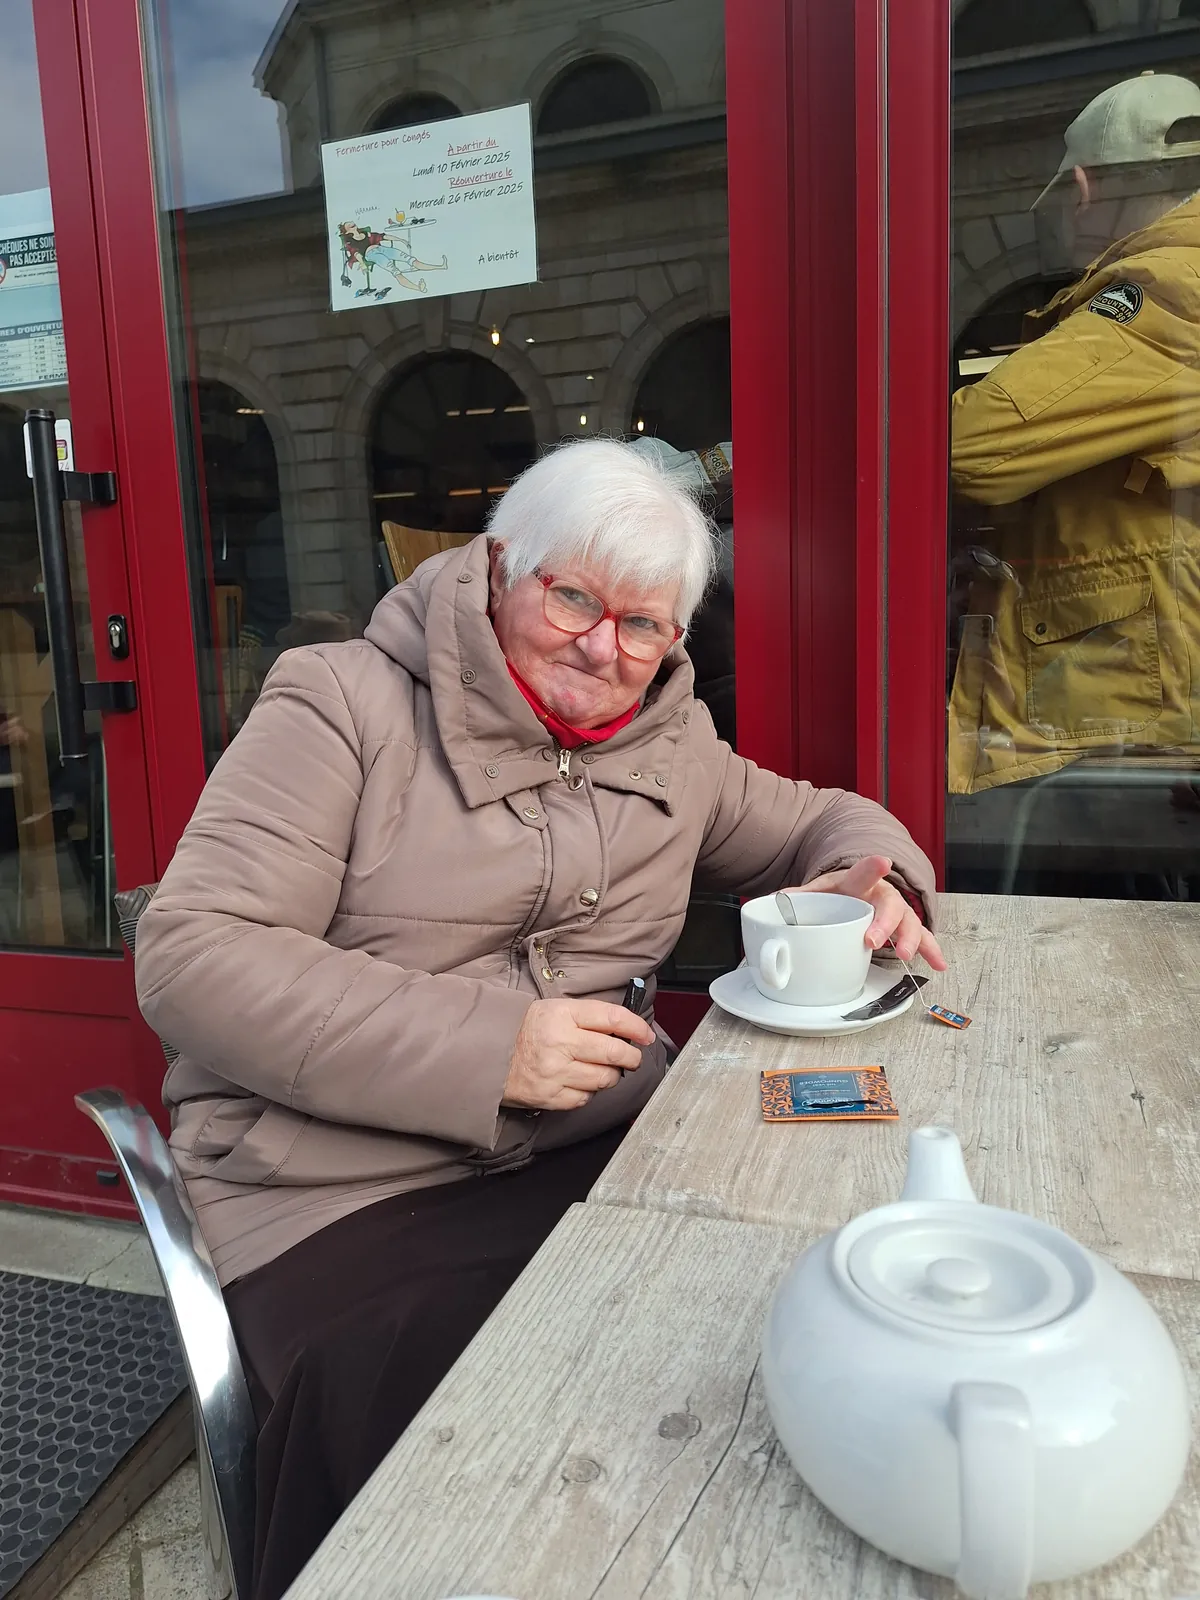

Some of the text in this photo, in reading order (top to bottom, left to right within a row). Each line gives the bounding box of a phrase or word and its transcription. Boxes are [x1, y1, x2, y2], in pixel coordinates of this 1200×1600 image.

[335, 129, 431, 157] Fermeture pour Congés
[456, 140, 483, 154] partir
[486, 137, 496, 147] du
[413, 150, 511, 177] Lundi 10 Février 2025
[448, 167, 513, 187] Réouverture le
[409, 181, 524, 210] Mercredi 26 Février 2025
[29, 238, 39, 250] NE
[9, 254, 23, 266] PAS
[487, 249, 519, 262] bientôt
[1095, 296, 1133, 318] MOUNTAIN
